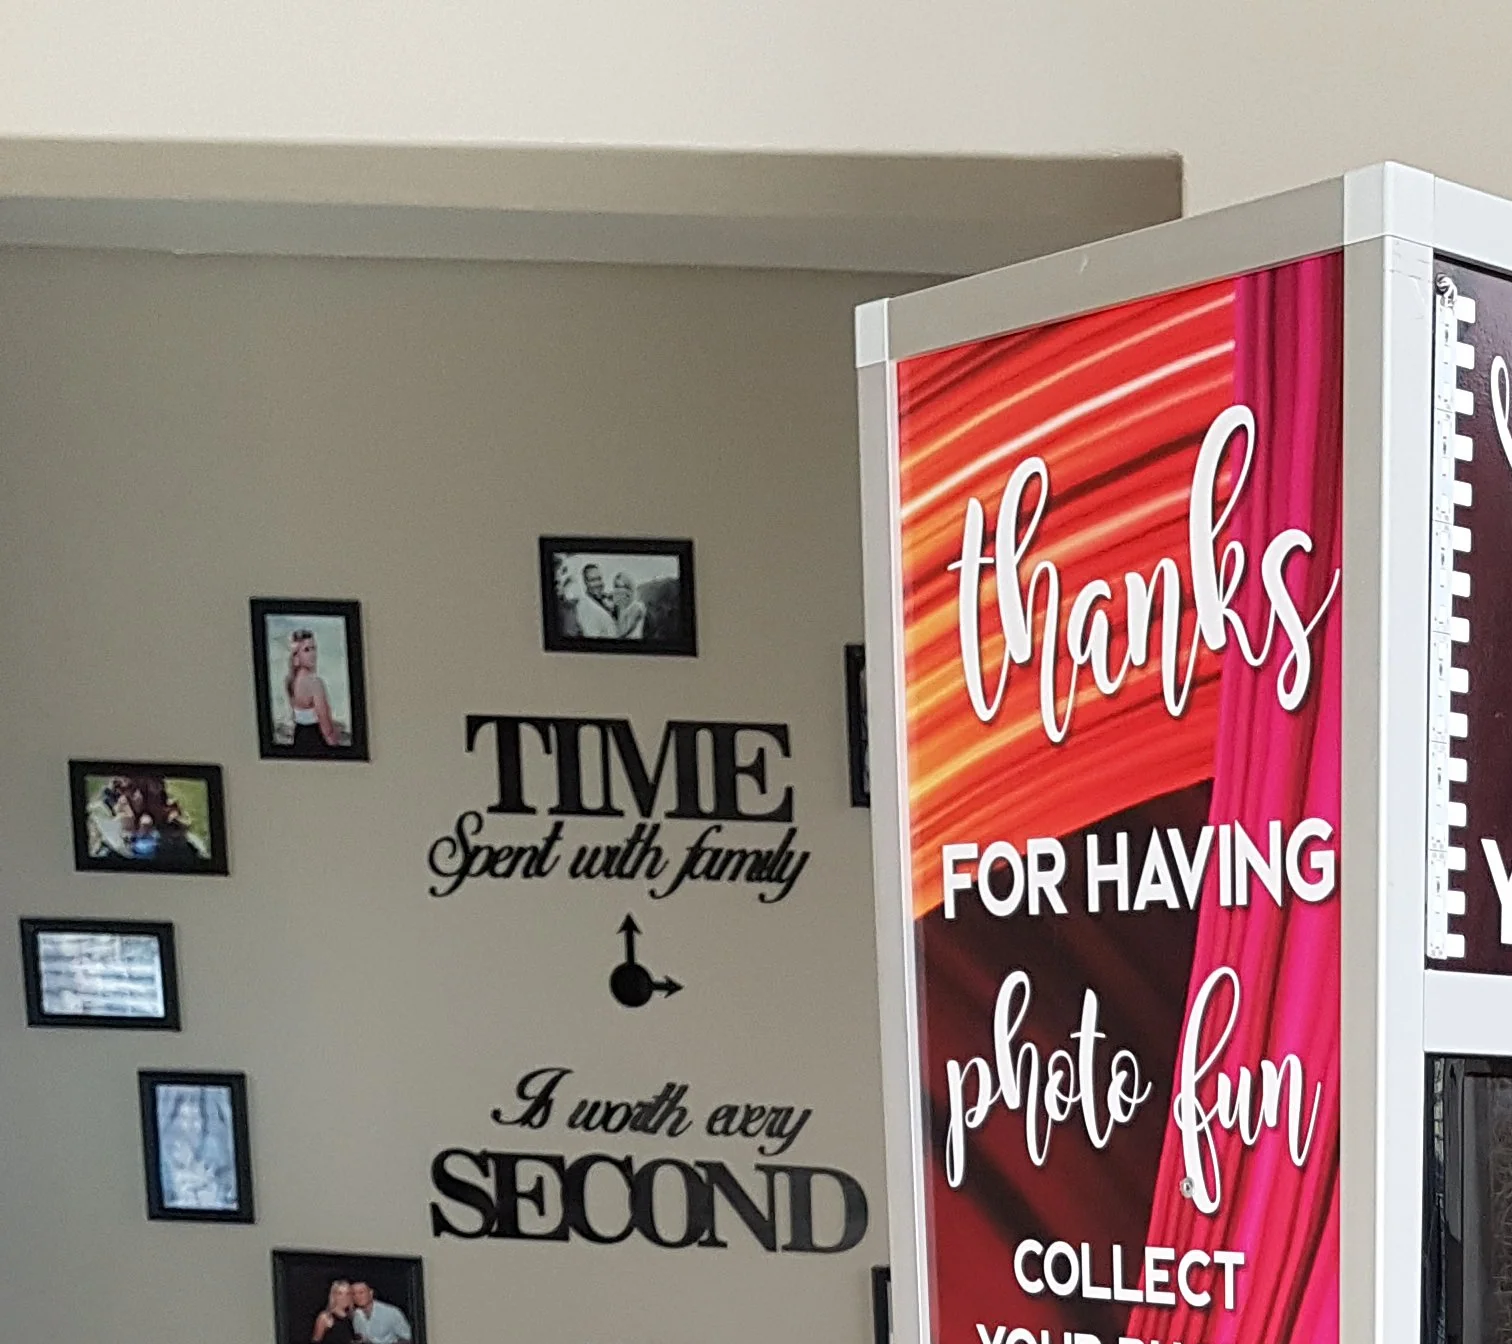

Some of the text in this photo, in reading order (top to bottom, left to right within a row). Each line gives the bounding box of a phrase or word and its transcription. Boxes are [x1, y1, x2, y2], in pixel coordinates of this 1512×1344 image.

[947, 405, 1341, 743] thanks
[466, 715, 793, 822] TIME
[429, 811, 810, 904] Spent with family
[941, 817, 1336, 919] FOR HAVING
[491, 1068, 812, 1158] Is worth every
[945, 966, 1321, 1214] photo fun
[431, 1147, 869, 1254] SECOND
[1014, 1238, 1245, 1310] COLLECT
